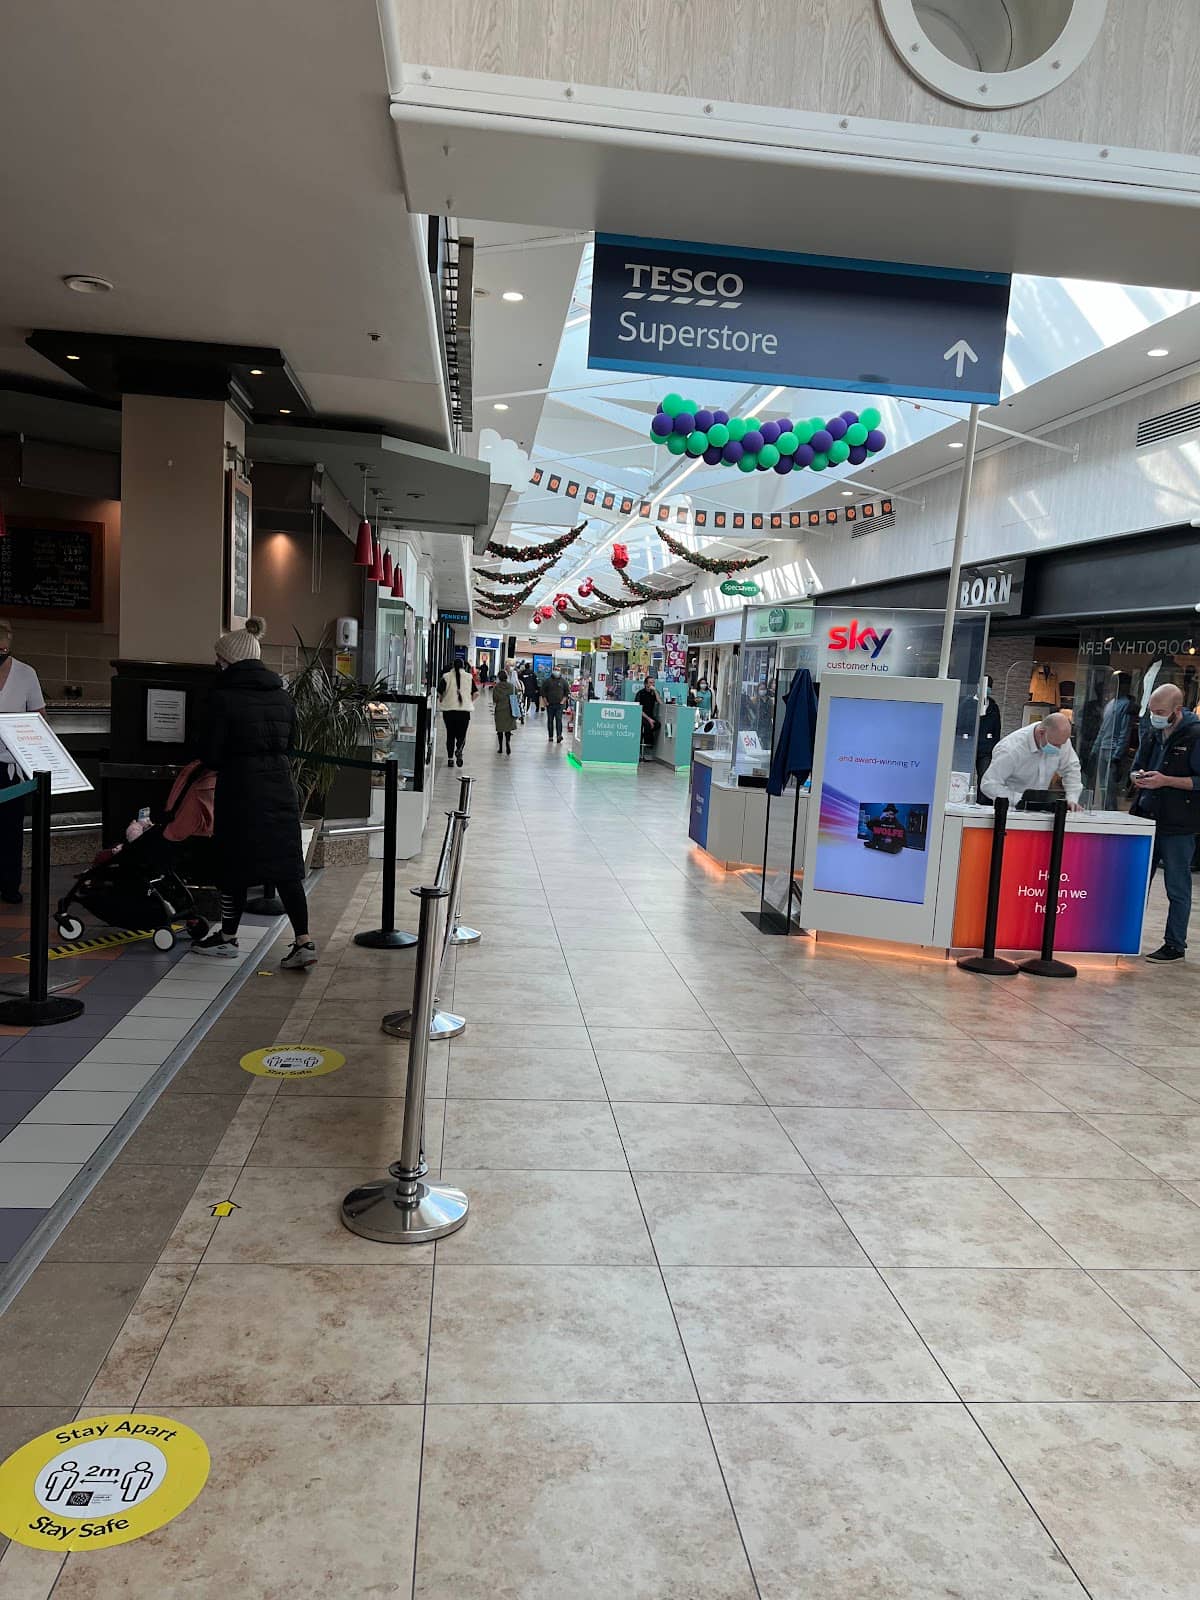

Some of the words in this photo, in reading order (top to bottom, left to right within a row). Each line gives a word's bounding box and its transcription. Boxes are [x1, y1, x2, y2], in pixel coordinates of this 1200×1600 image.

[624, 263, 744, 299] TESCO
[617, 311, 778, 355] Superstore
[724, 583, 757, 592] Specsavers
[960, 573, 1013, 606] BORN
[827, 618, 893, 659] sky
[826, 661, 870, 672] customer
[870, 662, 889, 673] hub
[616, 728, 635, 738] today
[839, 755, 854, 763] and
[854, 757, 908, 769] award-winning
[910, 760, 921, 768] TV
[1017, 885, 1046, 897] How
[1070, 889, 1088, 899] we
[55, 1421, 110, 1445] Stay
[114, 1421, 178, 1442] Apart
[84, 1465, 121, 1477] 2m
[28, 1515, 77, 1541] Stay
[78, 1518, 131, 1538] Safe
